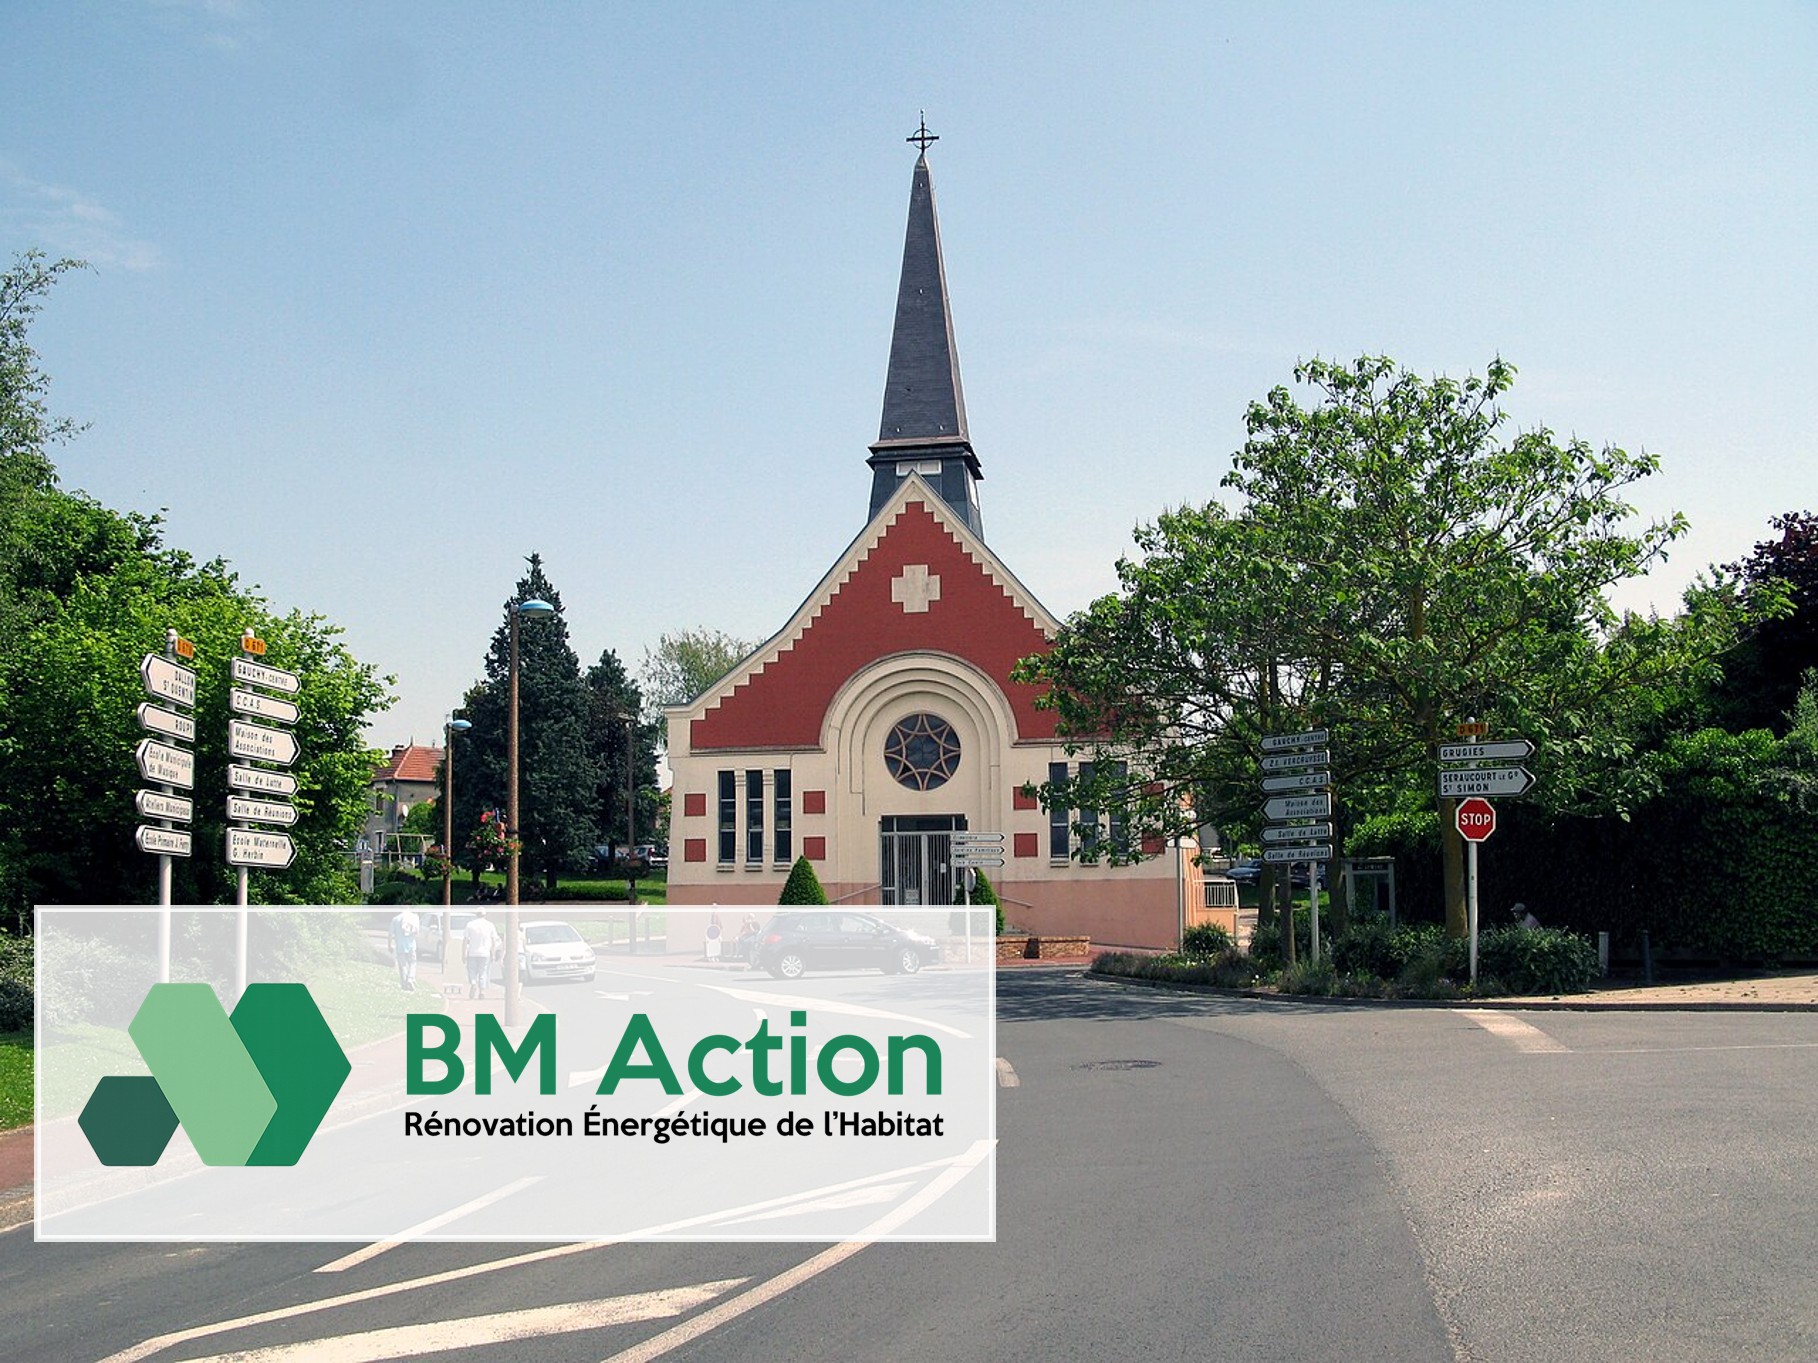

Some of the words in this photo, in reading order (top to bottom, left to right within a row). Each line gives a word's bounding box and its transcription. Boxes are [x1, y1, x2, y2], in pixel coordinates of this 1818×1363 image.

[235, 726, 258, 741] Maison
[262, 731, 273, 745] des
[234, 740, 275, 758] Associations
[1442, 746, 1485, 758] GRUGIES
[234, 770, 251, 783] Salle
[255, 774, 263, 786] de
[266, 776, 282, 788] Lutte
[1442, 771, 1497, 783] SERAUCOURT
[1456, 783, 1490, 793] SIMON
[233, 802, 250, 814] Salle
[253, 805, 261, 816] de
[264, 806, 292, 820] Réunions
[1460, 812, 1492, 826] STOP
[253, 836, 286, 850] Maternelle
